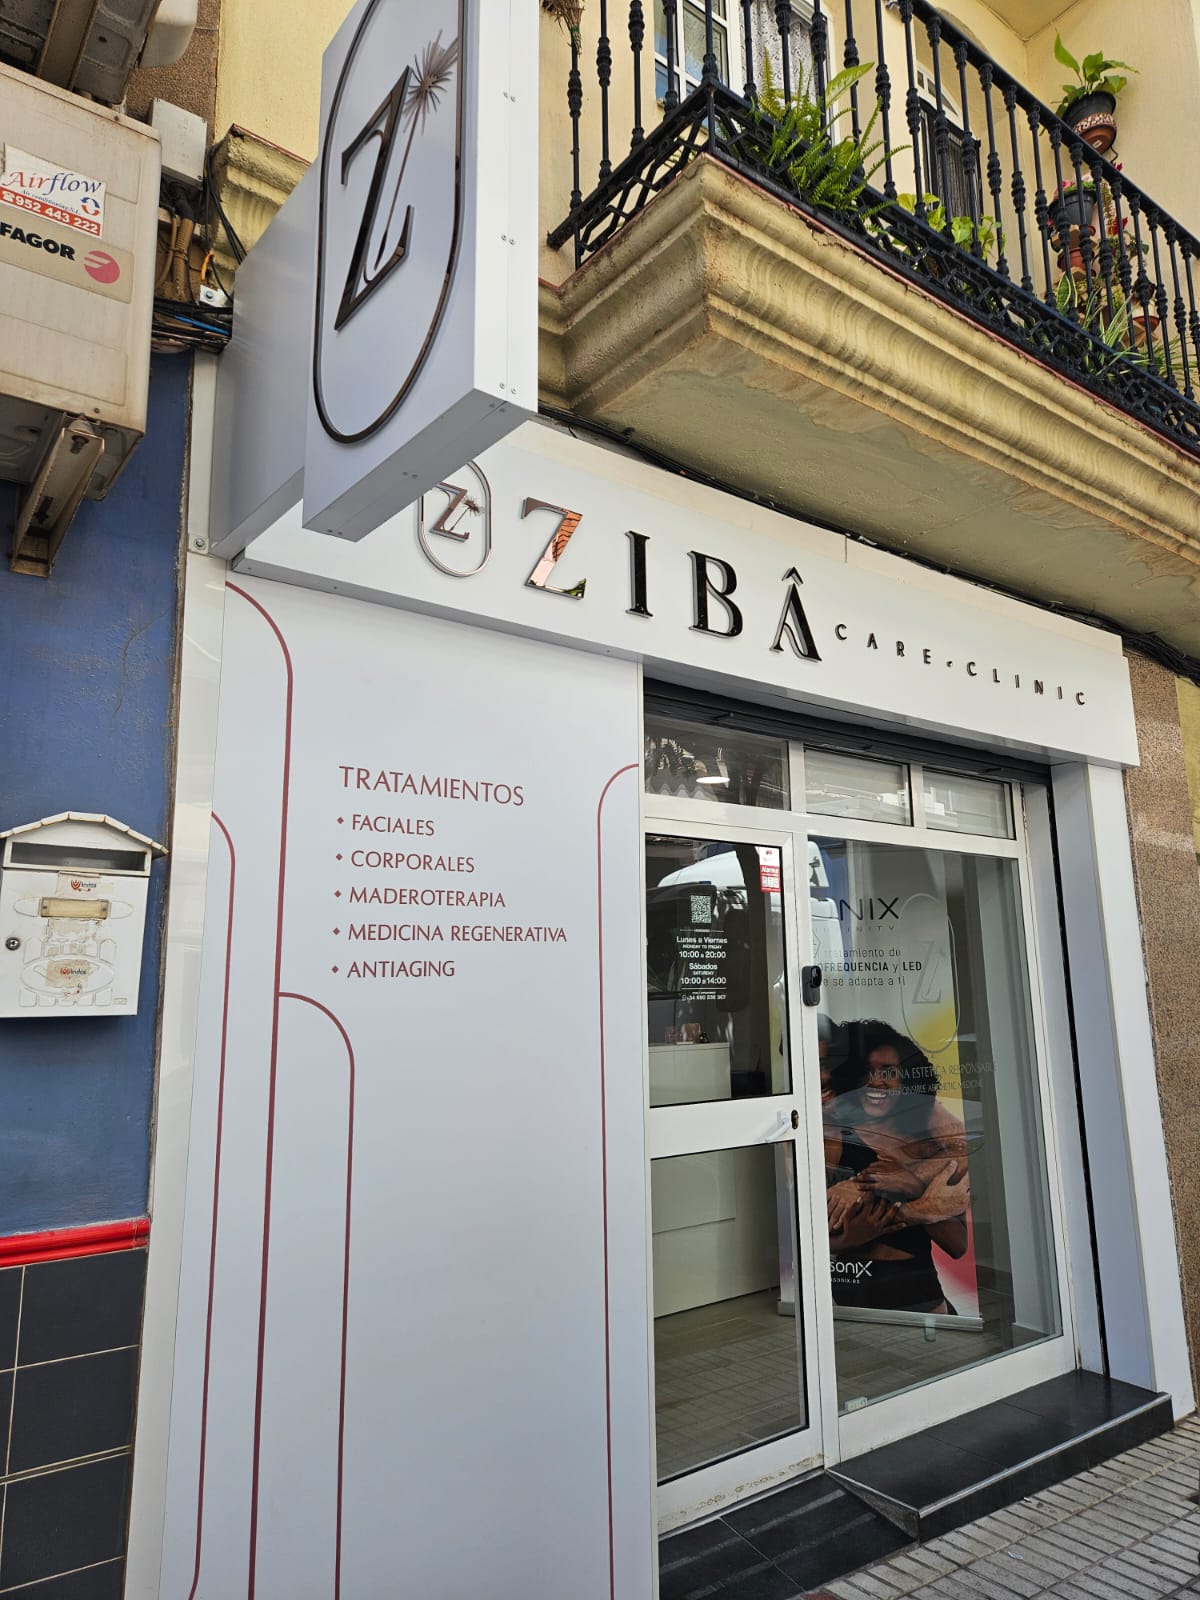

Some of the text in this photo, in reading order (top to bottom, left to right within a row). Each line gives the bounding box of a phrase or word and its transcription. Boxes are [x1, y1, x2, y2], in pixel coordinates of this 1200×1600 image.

[2, 170, 102, 196] Airflow
[15, 196, 98, 234] 952 443 222
[0, 221, 76, 261] FAGOR
[520, 496, 822, 663] ZIBÂ
[834, 623, 1086, 706] CARE CLINIC
[338, 765, 525, 806] TRATAMIENTOS
[352, 814, 435, 837] FACIALES
[350, 850, 475, 873] CORPORALES
[349, 886, 506, 908] MADEROTERAPIA
[839, 897, 899, 920] NIX
[348, 923, 567, 943] MEDICINA REGENERATIVA
[676, 936, 697, 944] Lunes
[704, 936, 728, 944] Viernes
[679, 951, 700, 959] 10:00
[705, 951, 727, 959] 20:00
[346, 960, 456, 979] ANTIAGING
[689, 962, 718, 971] Sábados
[819, 961, 922, 973] OFREQUENCIA y LED
[681, 977, 702, 985] 10:00
[707, 977, 727, 985] 14:00
[832, 978, 844, 986] se
[848, 976, 884, 987] adapta
[888, 978, 894, 986] a
[869, 1067, 909, 1081] MEDICINA
